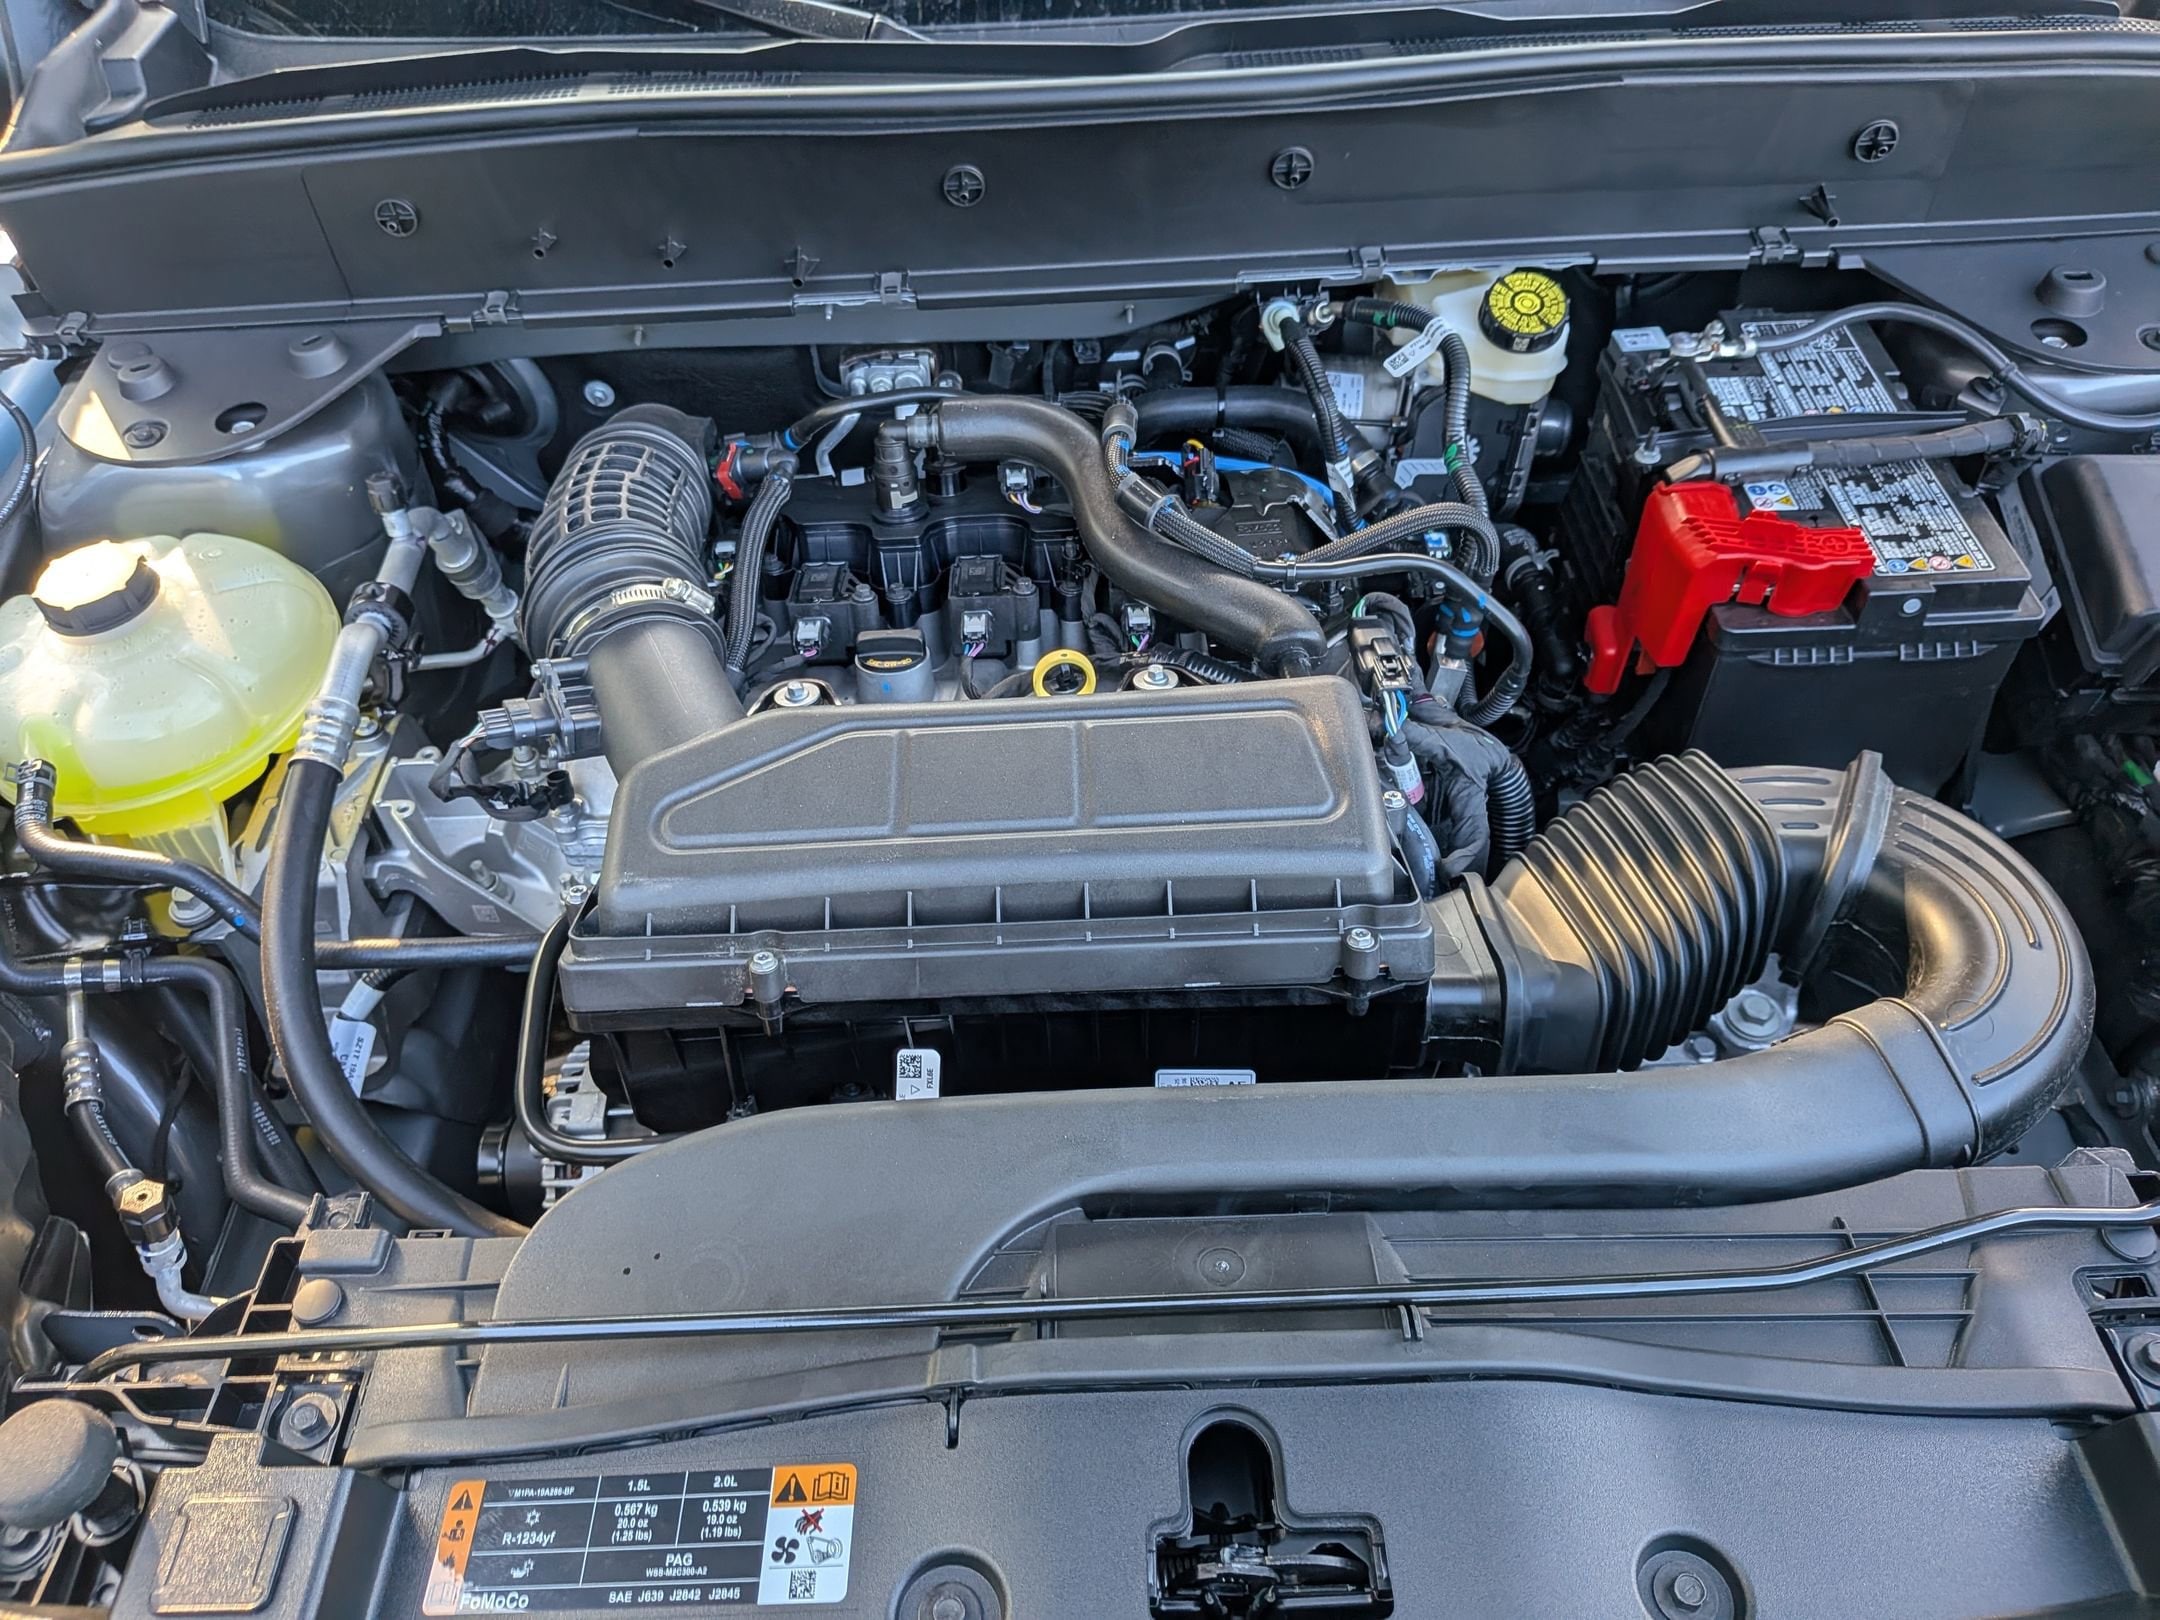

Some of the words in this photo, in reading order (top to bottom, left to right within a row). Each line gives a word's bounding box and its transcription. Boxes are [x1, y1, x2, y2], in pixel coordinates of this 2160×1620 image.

[713, 1475, 738, 1488] 2.0L
[614, 1503, 642, 1517] 0.567
[644, 1502, 659, 1518] kg
[702, 1499, 731, 1513] 0.539
[733, 1498, 747, 1514] kg
[616, 1518, 636, 1529] 20.0
[637, 1519, 648, 1528] oz
[706, 1514, 725, 1525] 19.0
[726, 1515, 738, 1524] oz
[501, 1530, 557, 1547] R-1234yf
[635, 1529, 652, 1543] lbs)
[700, 1527, 723, 1541] (1.19
[724, 1525, 742, 1540] lbs)
[665, 1552, 693, 1567] PAG
[459, 1591, 529, 1610] FoMoCo
[608, 1590, 633, 1603] SAE
[638, 1589, 664, 1603] J639
